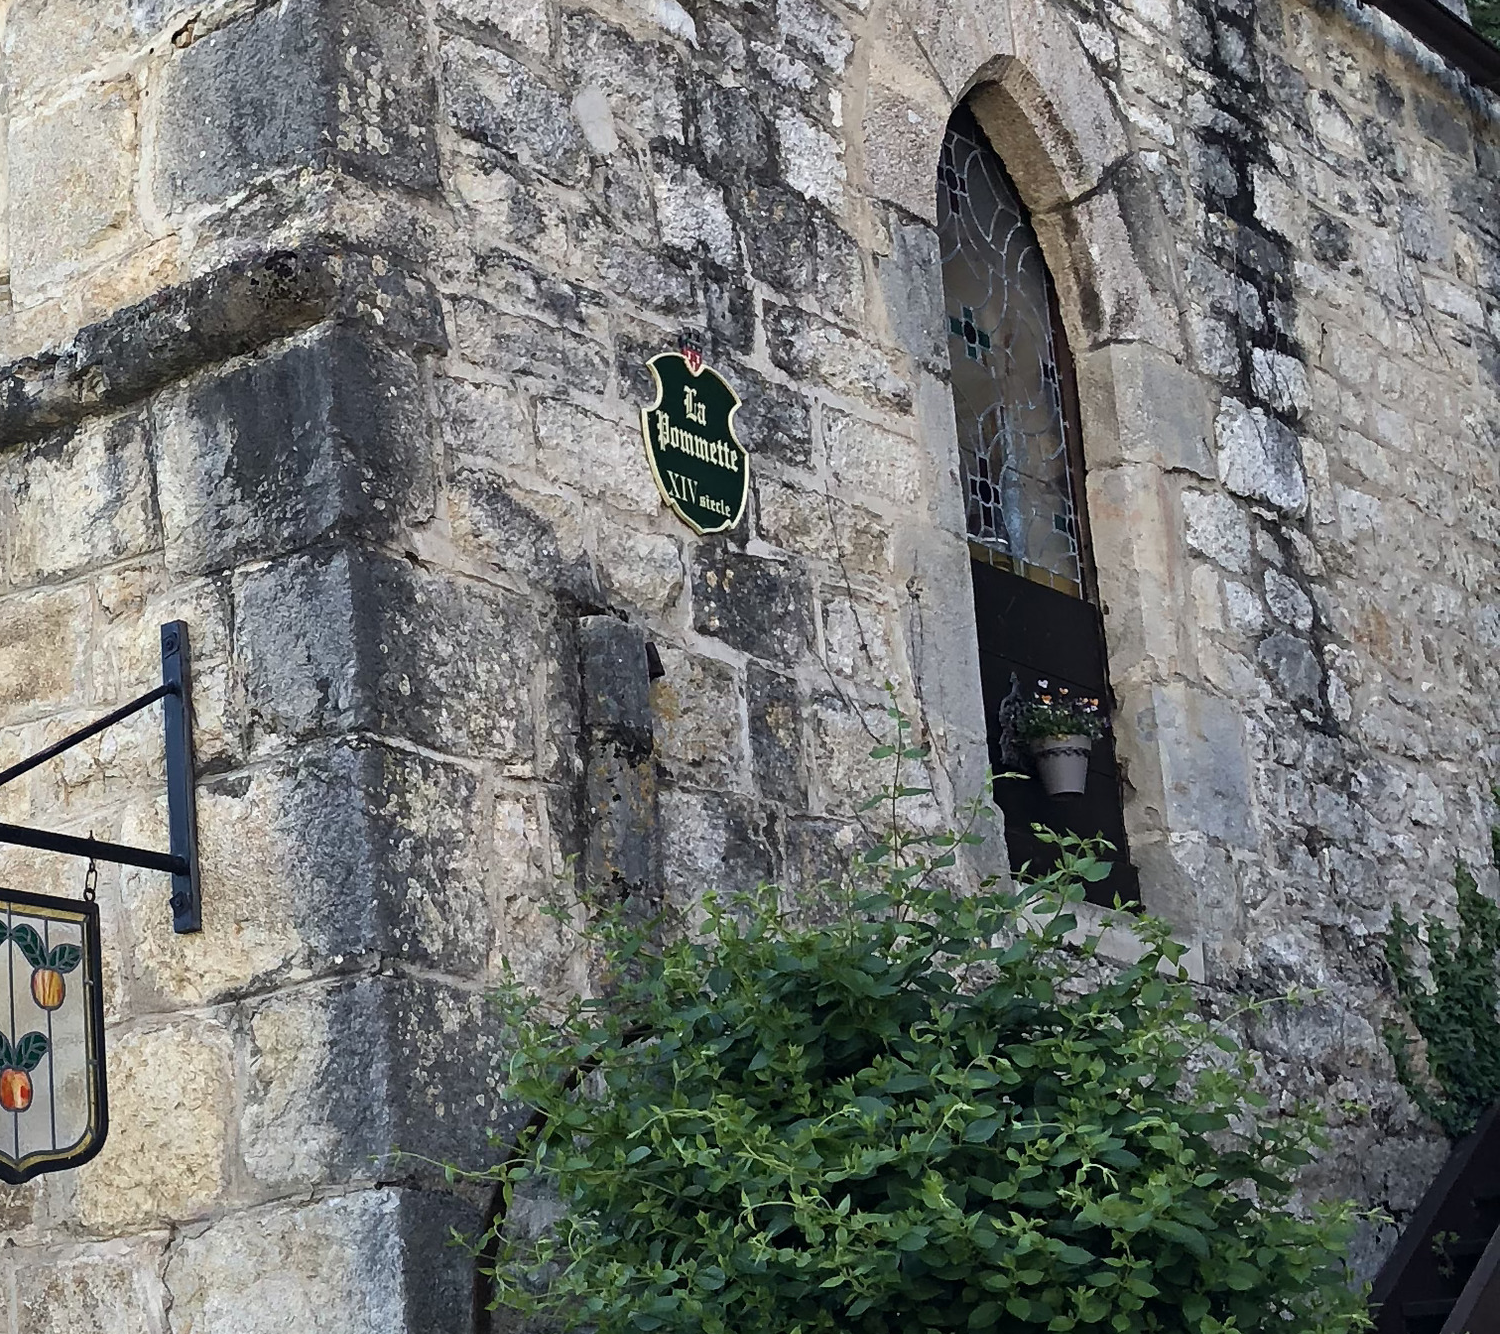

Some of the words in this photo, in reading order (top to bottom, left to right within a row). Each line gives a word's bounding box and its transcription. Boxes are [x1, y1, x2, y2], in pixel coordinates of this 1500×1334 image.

[683, 384, 707, 426] La
[656, 409, 739, 473] Pommette
[666, 469, 699, 505] XIV
